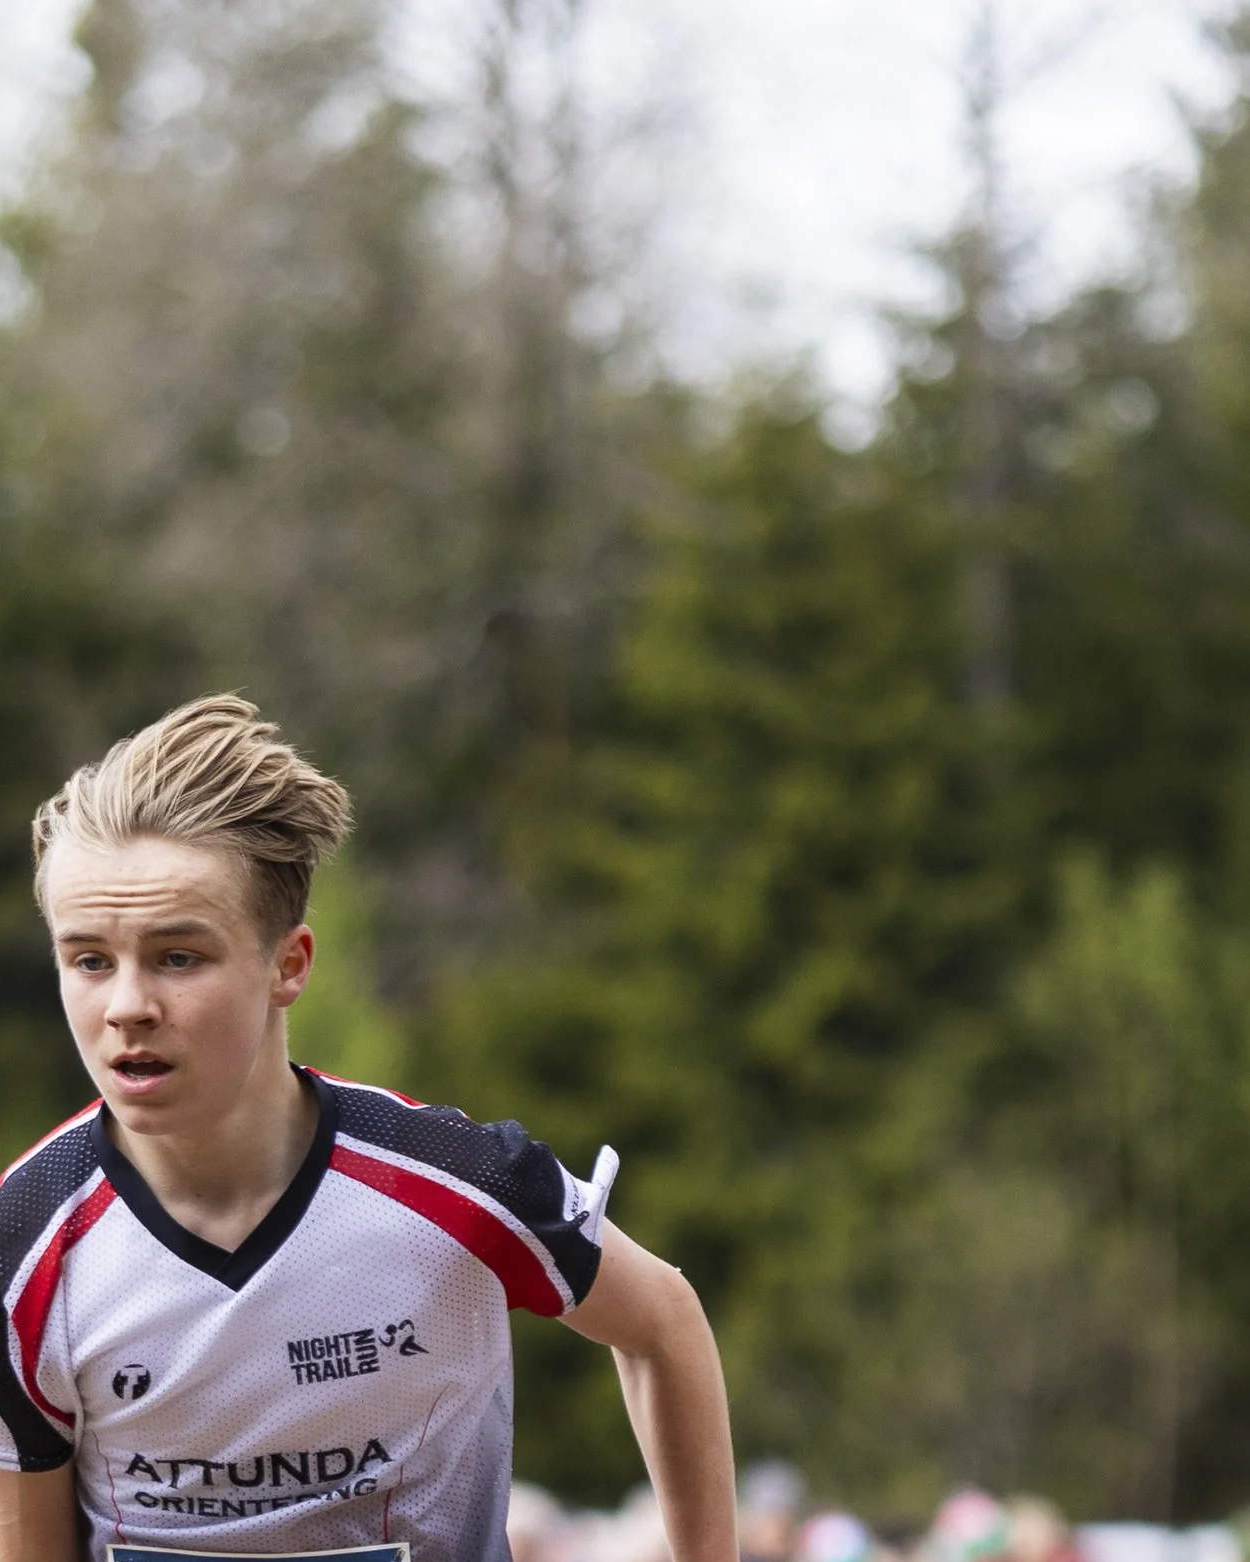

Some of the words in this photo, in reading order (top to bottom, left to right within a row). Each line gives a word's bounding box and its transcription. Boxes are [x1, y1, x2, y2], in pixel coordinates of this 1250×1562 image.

[287, 1332, 352, 1364] NIGHT
[353, 1328, 381, 1375] RUN
[290, 1356, 359, 1386] TRAIL
[125, 1437, 394, 1489] ATTUNDA
